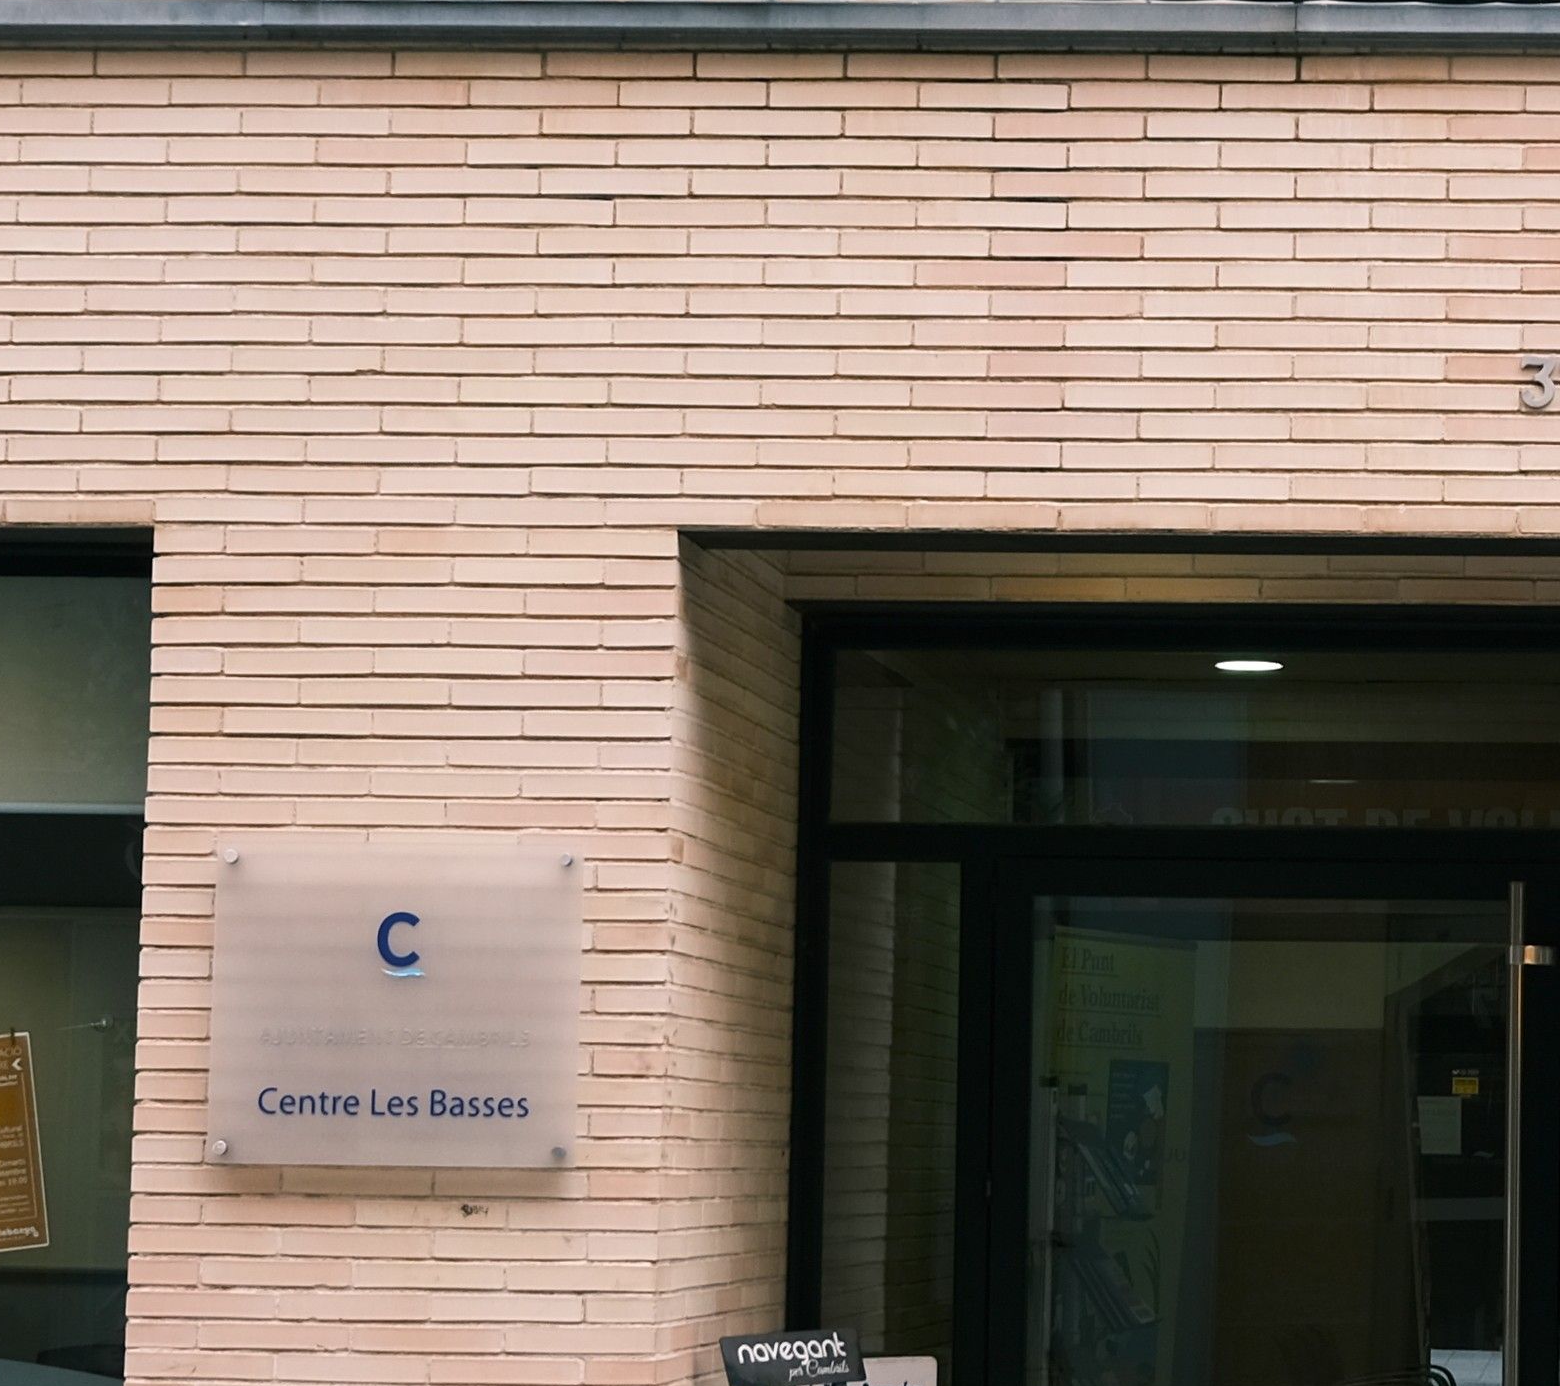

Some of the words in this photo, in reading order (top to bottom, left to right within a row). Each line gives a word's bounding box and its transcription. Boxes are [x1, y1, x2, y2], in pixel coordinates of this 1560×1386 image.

[377, 912, 420, 967] C
[258, 1088, 359, 1116] Centre
[371, 1089, 418, 1116] Les
[430, 1090, 529, 1118] Basses
[738, 1332, 847, 1365] navegant
